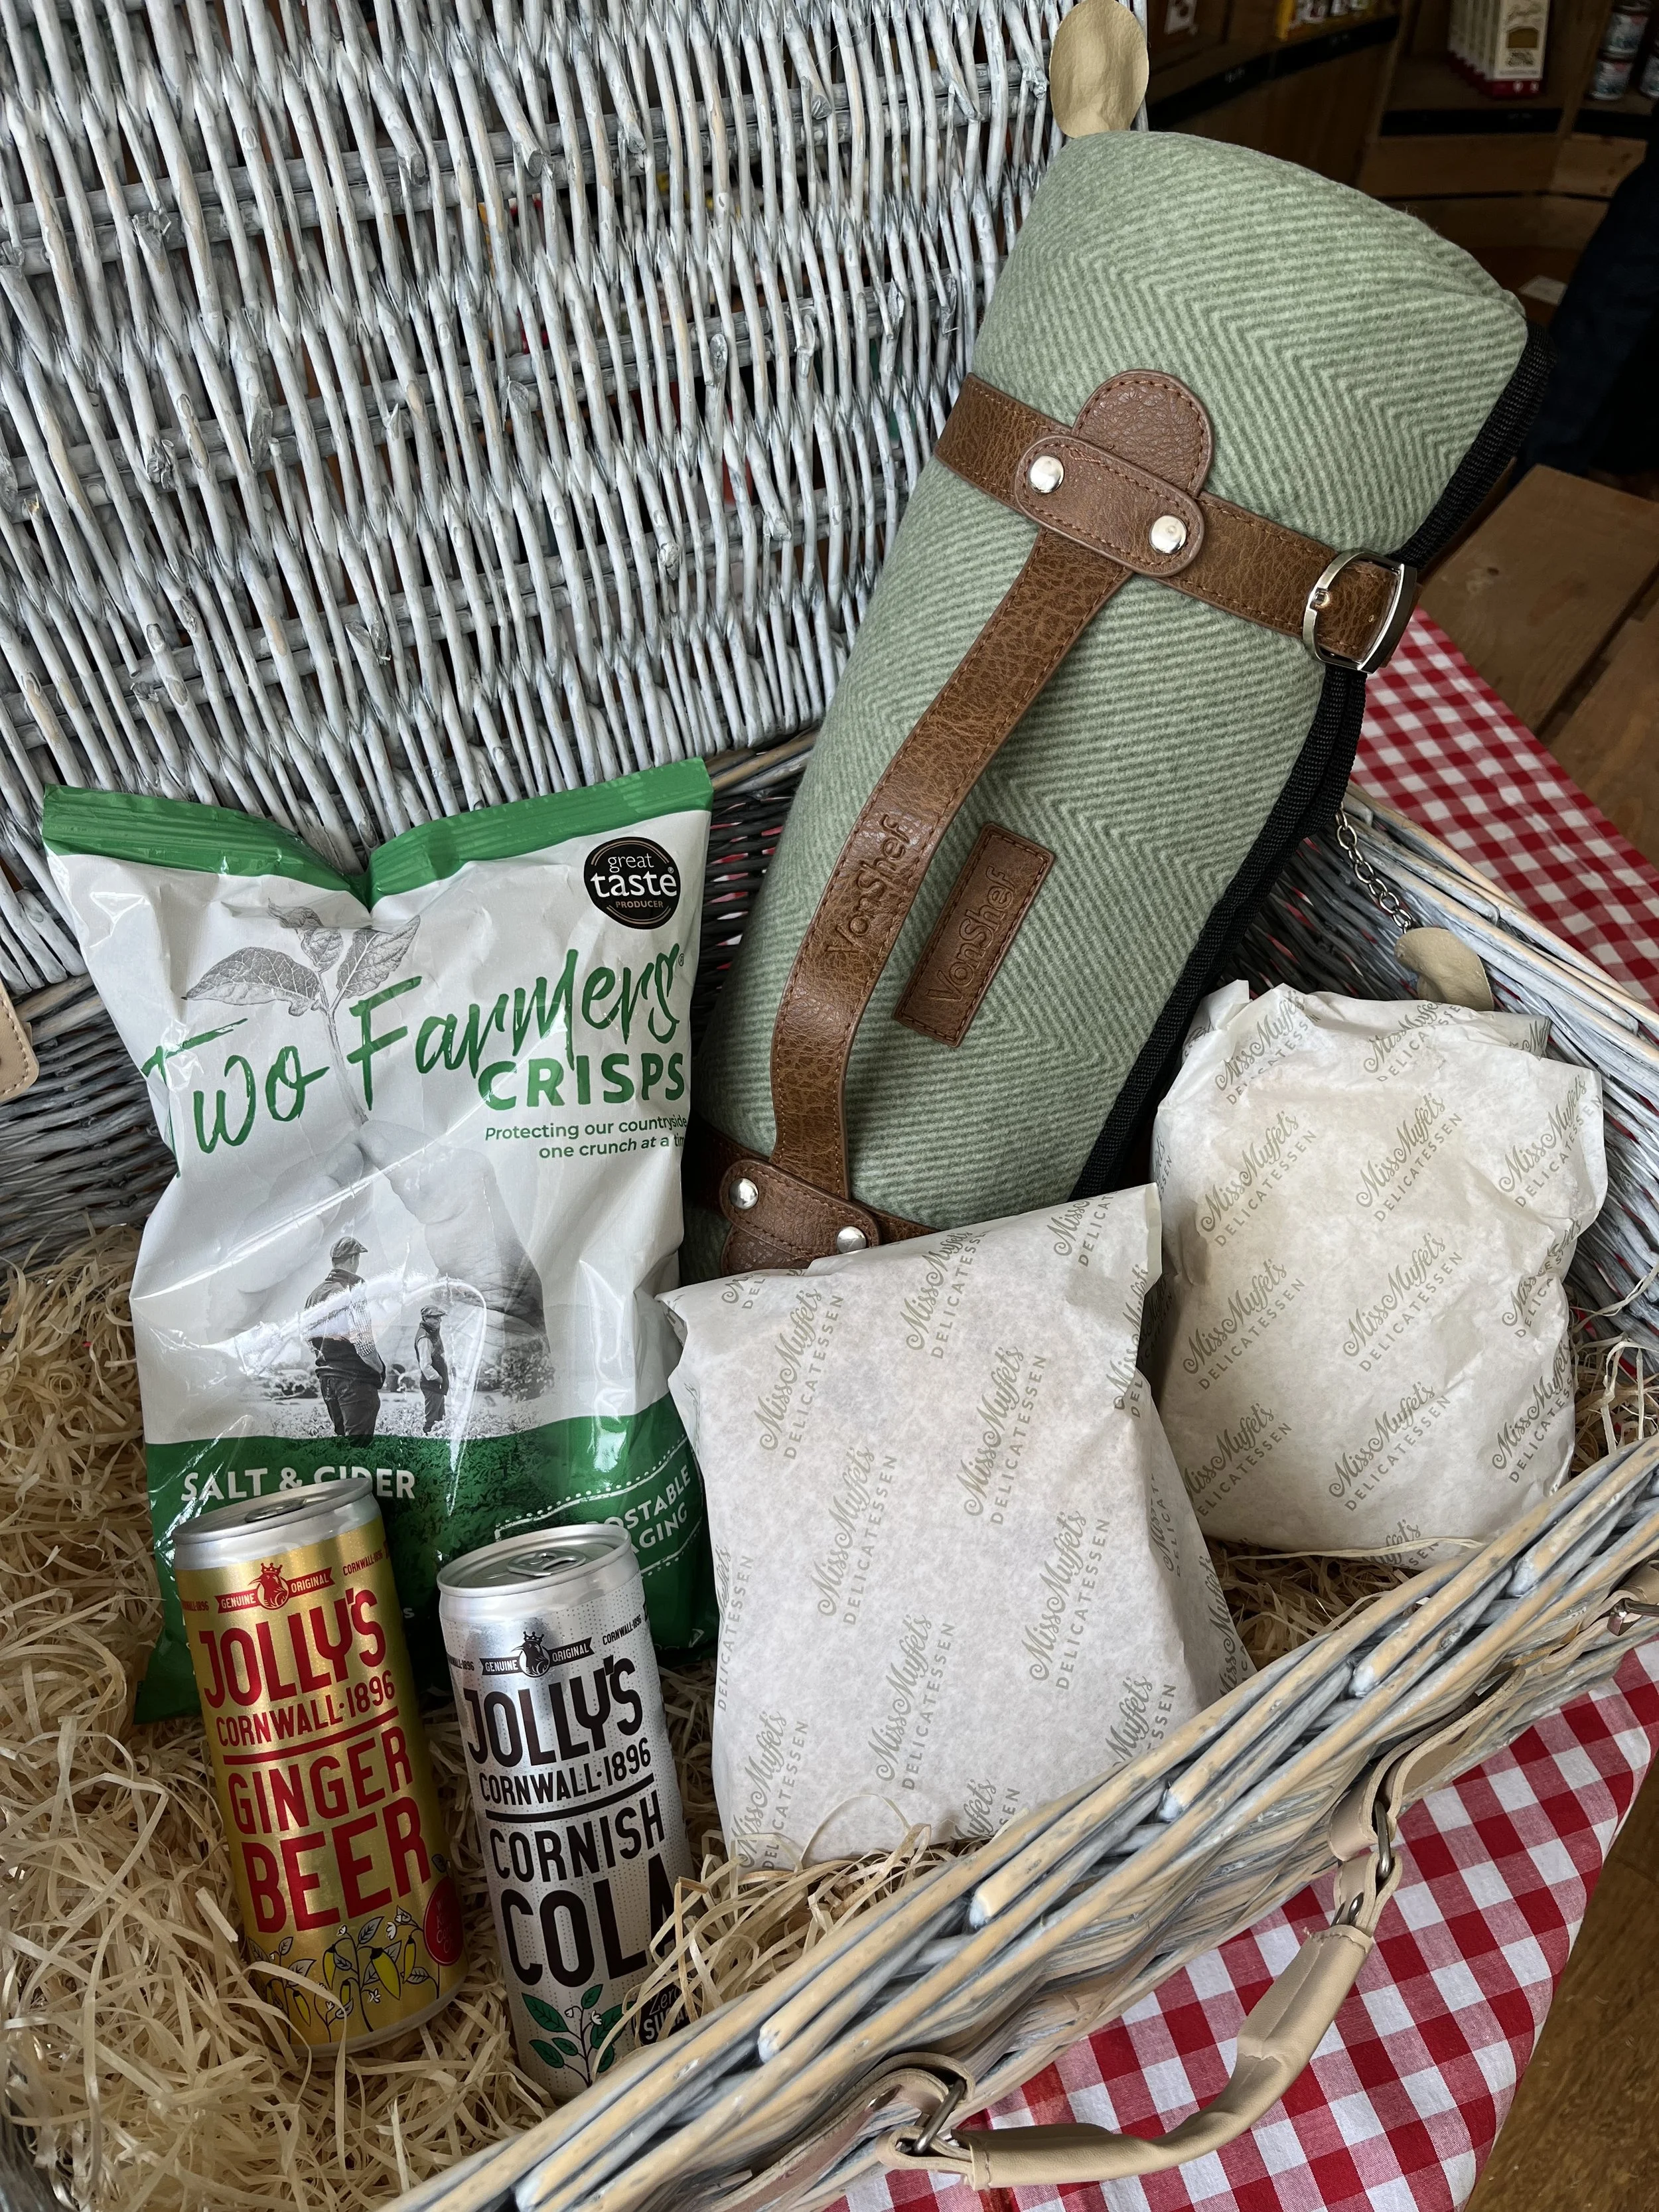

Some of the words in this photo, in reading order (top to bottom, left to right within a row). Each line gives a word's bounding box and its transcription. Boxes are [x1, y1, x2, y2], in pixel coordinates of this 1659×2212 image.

[590, 871, 678, 898] taste
[608, 853, 654, 873] great
[825, 814, 910, 955] VonShef
[927, 865, 1016, 1002] VonShef
[346, 943, 680, 1111] Farmers
[478, 1053, 684, 1110] CRISPS
[485, 1122, 579, 1141] Protecting
[585, 1122, 614, 1136] our
[618, 1114, 687, 1132] countryside
[539, 1145, 574, 1158] one
[579, 1138, 636, 1157] crunch
[641, 1136, 656, 1149] at
[660, 1137, 670, 1147] a
[674, 1132, 685, 1147] tim
[1374, 1114, 1463, 1222] DELICATESSEN
[1514, 1096, 1603, 1208] DELICATESSEN
[1214, 1130, 1317, 1247] DELICATESSEN
[1198, 1278, 1305, 1390] DELICATESSEN
[1359, 1252, 1463, 1372] DELICATESSEN
[784, 1295, 844, 1460] DELICATESSEN
[181, 1467, 268, 1502] SALT
[991, 1355, 1046, 1525] DELICATESSEN
[1197, 1423, 1292, 1516] ELICATESSEN
[1344, 1396, 1451, 1511] DELICATESSEN
[221, 1593, 255, 1609] GENUINE
[291, 1572, 329, 1593] ORIGINAL
[843, 1455, 899, 1625] DELICATESSEN
[199, 1587, 386, 1708] JOLLY'S
[485, 1660, 518, 1672] GENUINE
[552, 1647, 589, 1662] ORIGINAL
[717, 1555, 755, 1712] DELICATESSEN
[1056, 1519, 1110, 1690] DELICATESSEN
[463, 1655, 643, 1768] JOLLY'S
[902, 1623, 956, 1791] DELICATESSEN
[228, 1726, 413, 1834] GINGER
[490, 1789, 664, 1883] CORNISH
[242, 1797, 431, 1933] BEER
